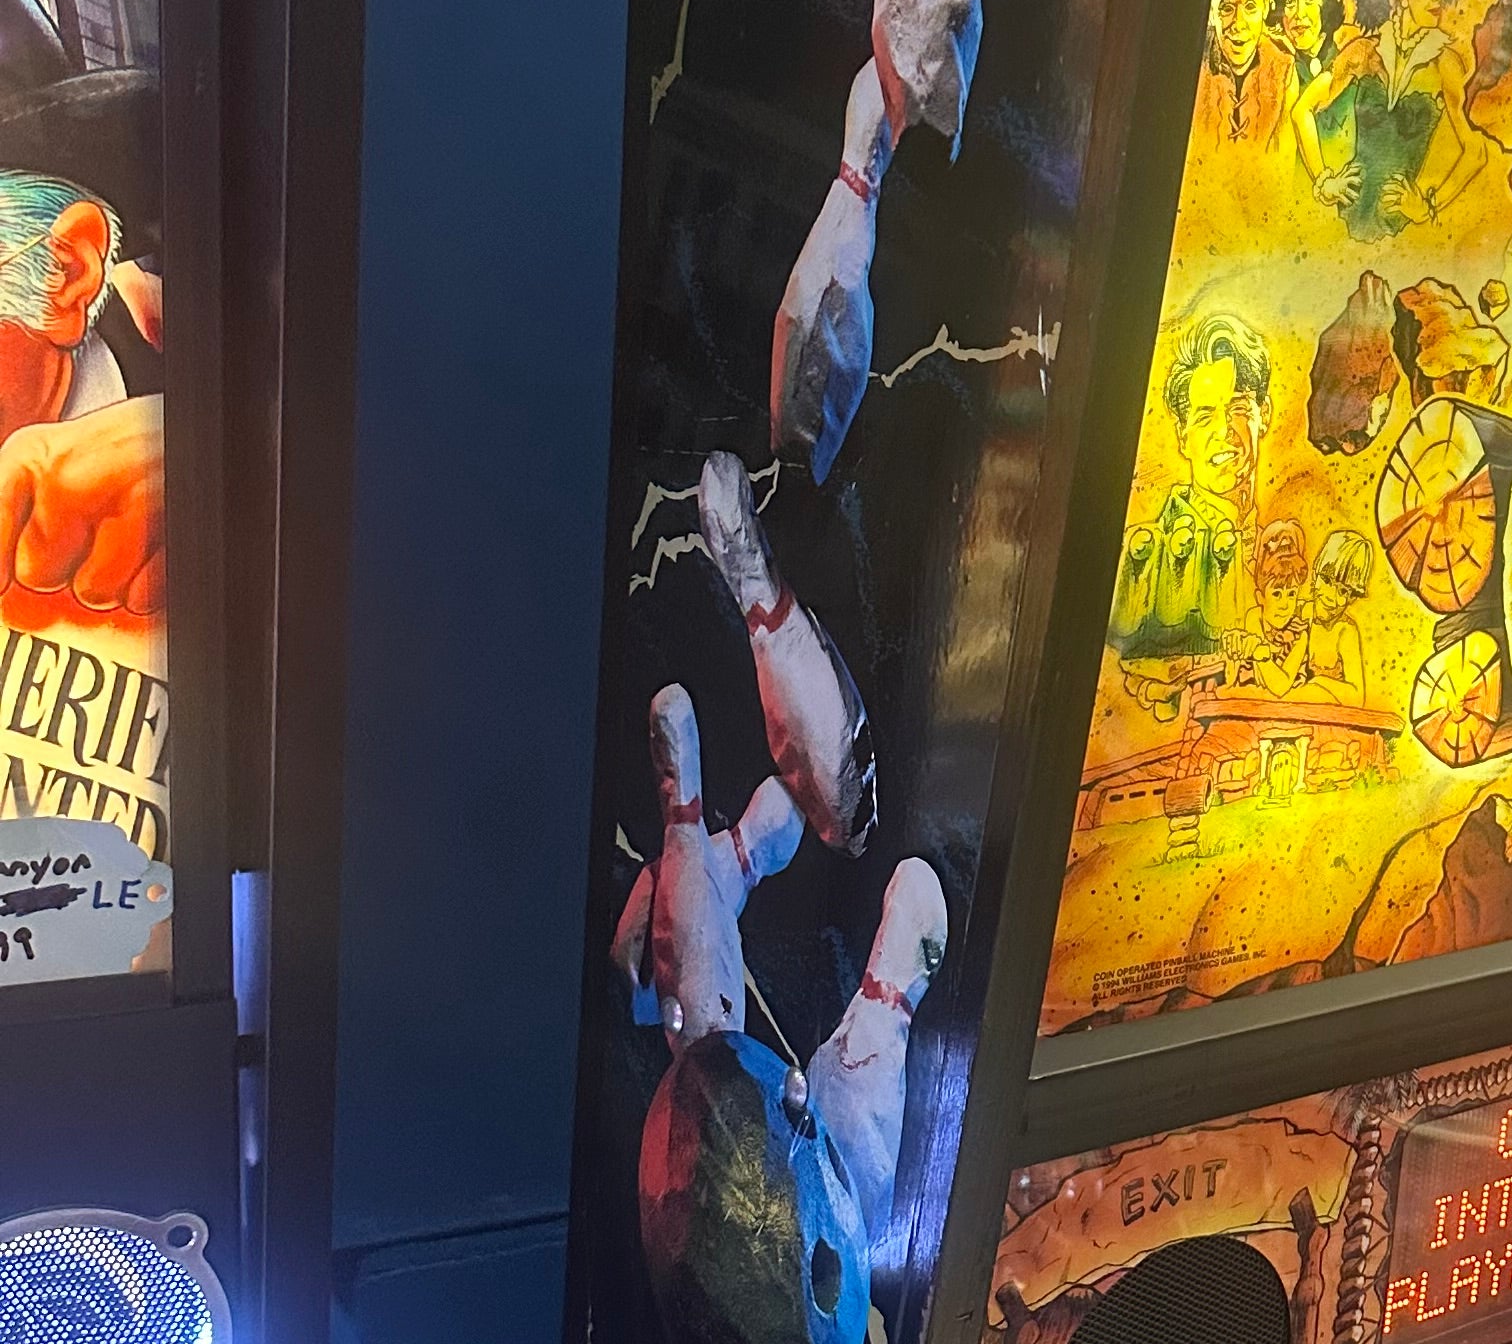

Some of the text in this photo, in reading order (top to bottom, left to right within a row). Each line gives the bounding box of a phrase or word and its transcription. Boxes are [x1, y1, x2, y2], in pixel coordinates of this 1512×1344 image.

[1093, 945, 1236, 982] COIN OPERATED PINBALL MACHINE
[1121, 970, 1162, 986] WILLIAMS
[1163, 957, 1220, 977] ELECTRONICS
[1091, 975, 1188, 1002] ALL RIGHTS RESERVED
[1119, 1158, 1228, 1227] EXIT
